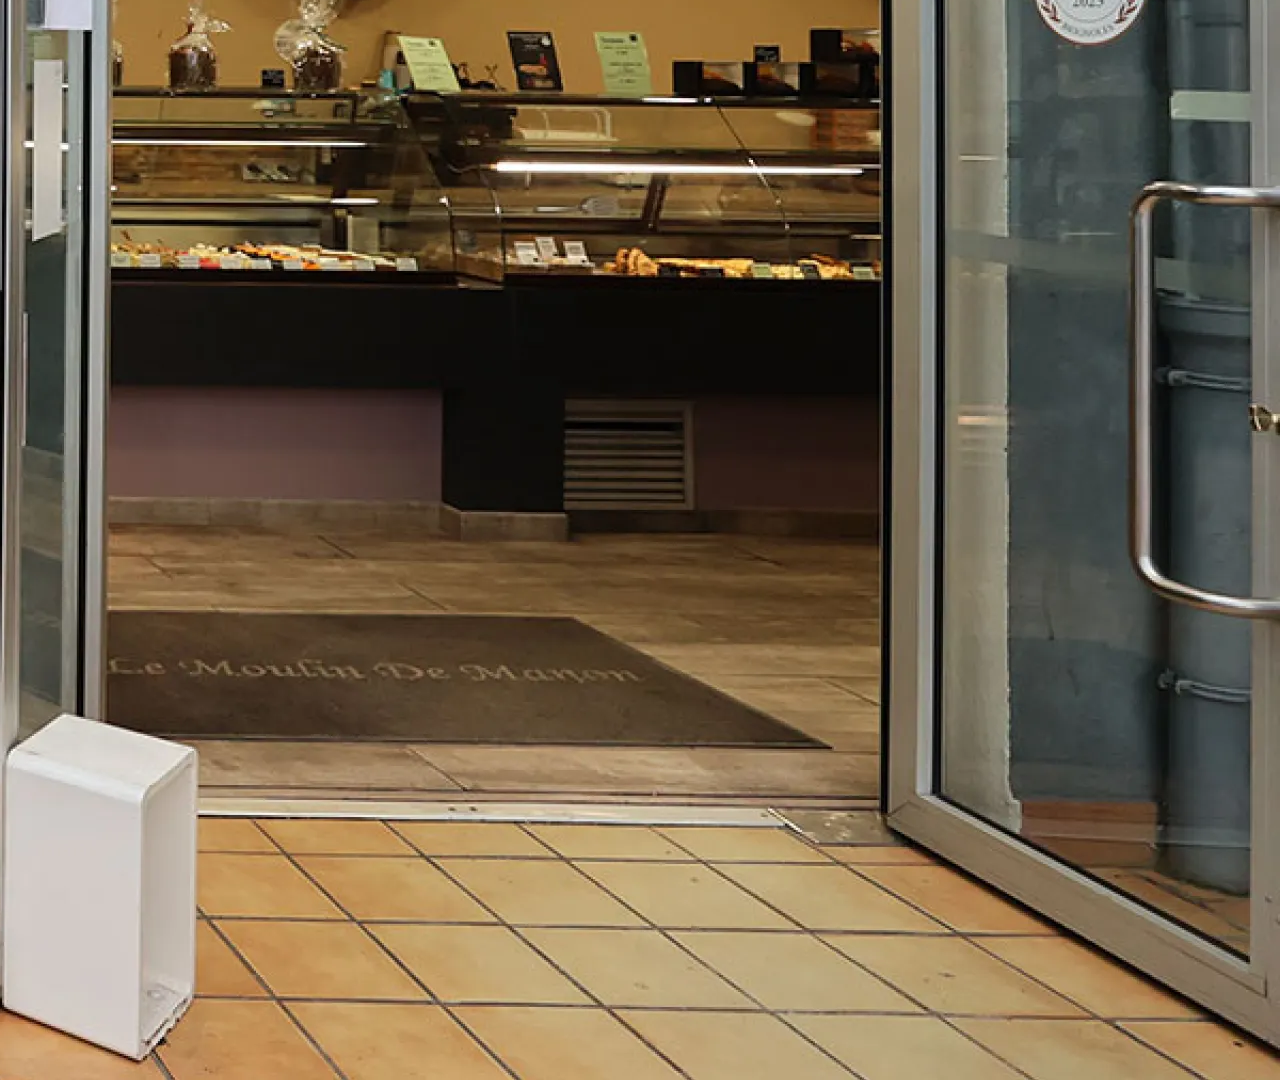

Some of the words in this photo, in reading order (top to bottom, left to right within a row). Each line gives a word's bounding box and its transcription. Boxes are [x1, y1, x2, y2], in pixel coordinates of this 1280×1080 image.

[108, 658, 167, 676] Le
[178, 657, 366, 681] Moulin
[373, 662, 450, 682] De
[458, 664, 645, 684] Manon
